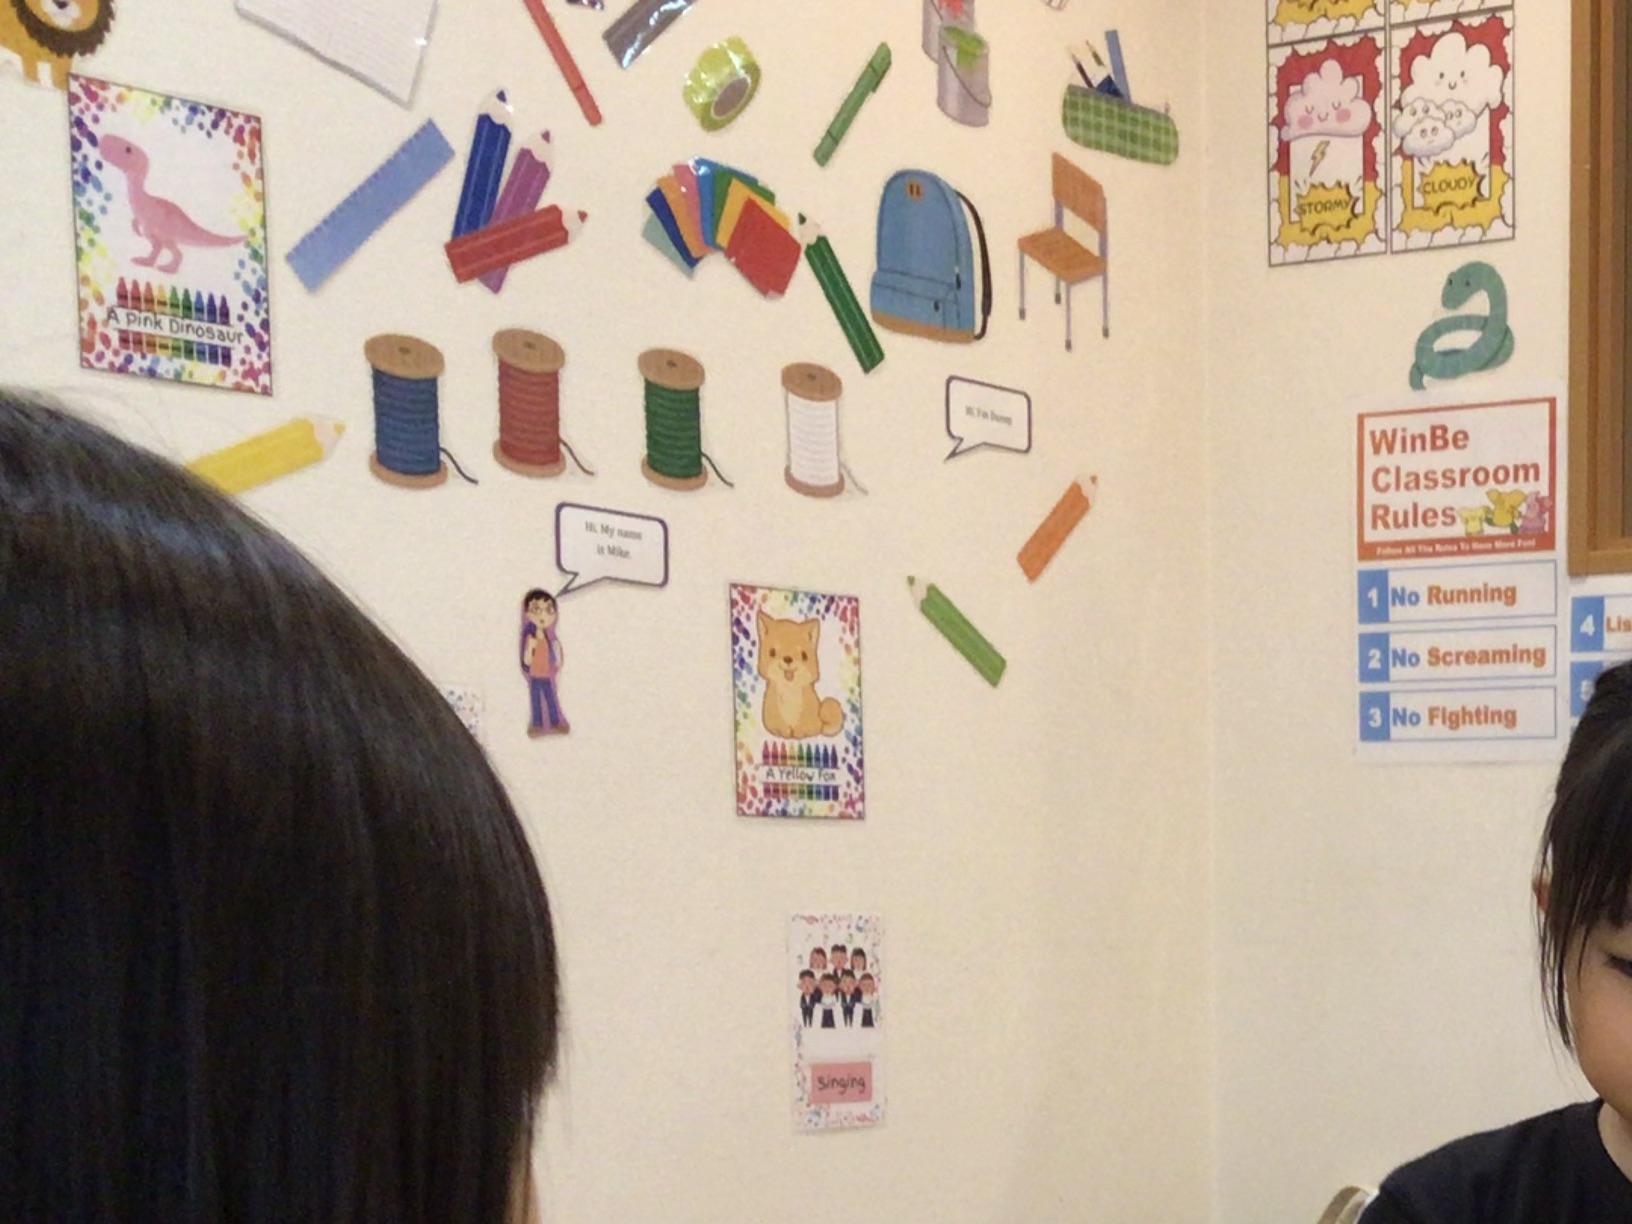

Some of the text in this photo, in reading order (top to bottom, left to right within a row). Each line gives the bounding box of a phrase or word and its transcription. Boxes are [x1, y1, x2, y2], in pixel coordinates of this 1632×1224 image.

[1423, 176, 1475, 194] CLOUDY
[1300, 199, 1351, 215] STORMY
[107, 308, 119, 323] A
[169, 318, 244, 344] Dinosaur
[1370, 424, 1469, 455] WinBe
[1372, 463, 1540, 493] Classroom
[1371, 502, 1457, 530] Rules
[1368, 583, 1517, 608] 1 No Running
[1580, 614, 1595, 636] 4
[1368, 643, 1546, 669] 2 No Screaming
[1369, 705, 1517, 730] 3 No Fighting
[766, 767, 775, 779] A
[779, 766, 815, 782] Yellow
